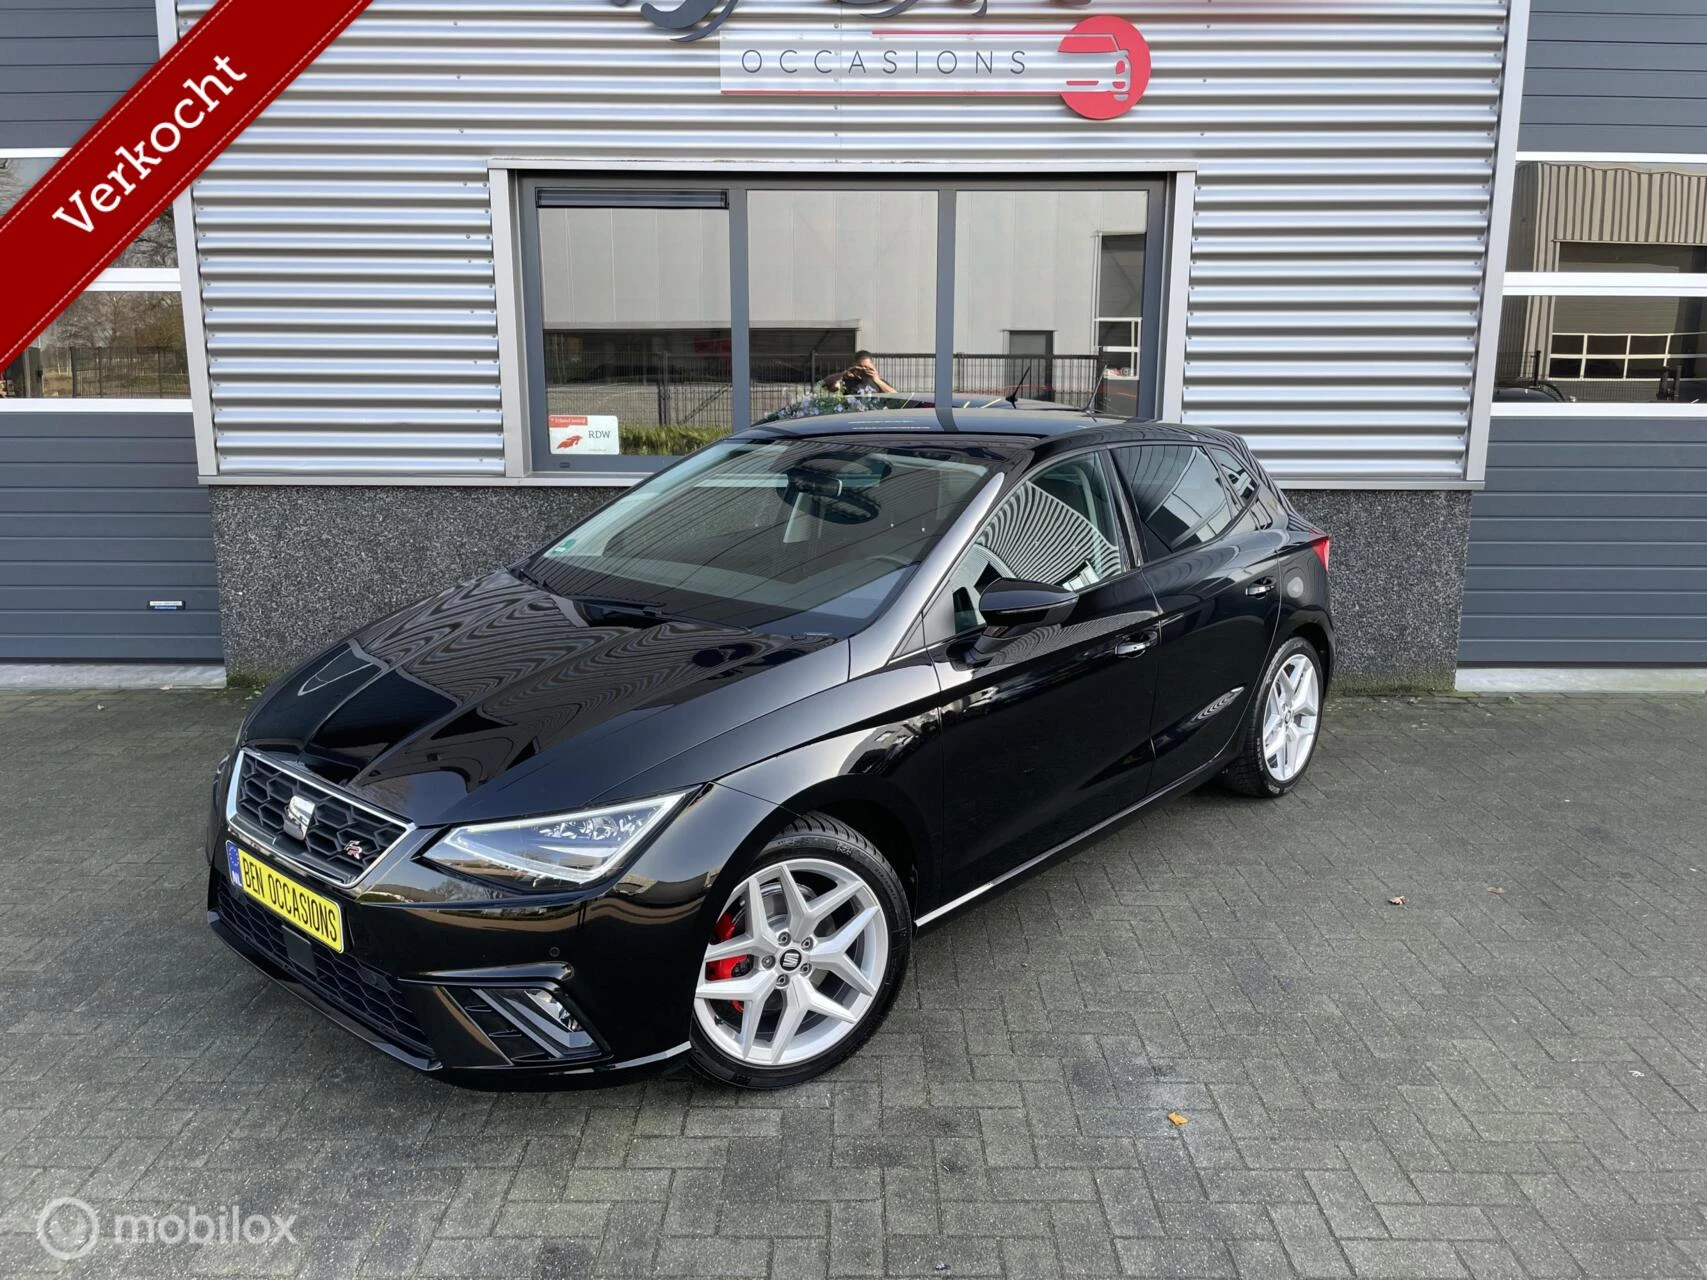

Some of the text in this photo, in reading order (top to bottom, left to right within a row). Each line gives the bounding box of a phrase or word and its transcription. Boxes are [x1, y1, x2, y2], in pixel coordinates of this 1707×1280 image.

[741, 48, 1027, 75] OCCASIONS
[588, 430, 611, 439] RDW
[231, 870, 243, 887] NL
[242, 857, 338, 943] BEN OCCASIONS
